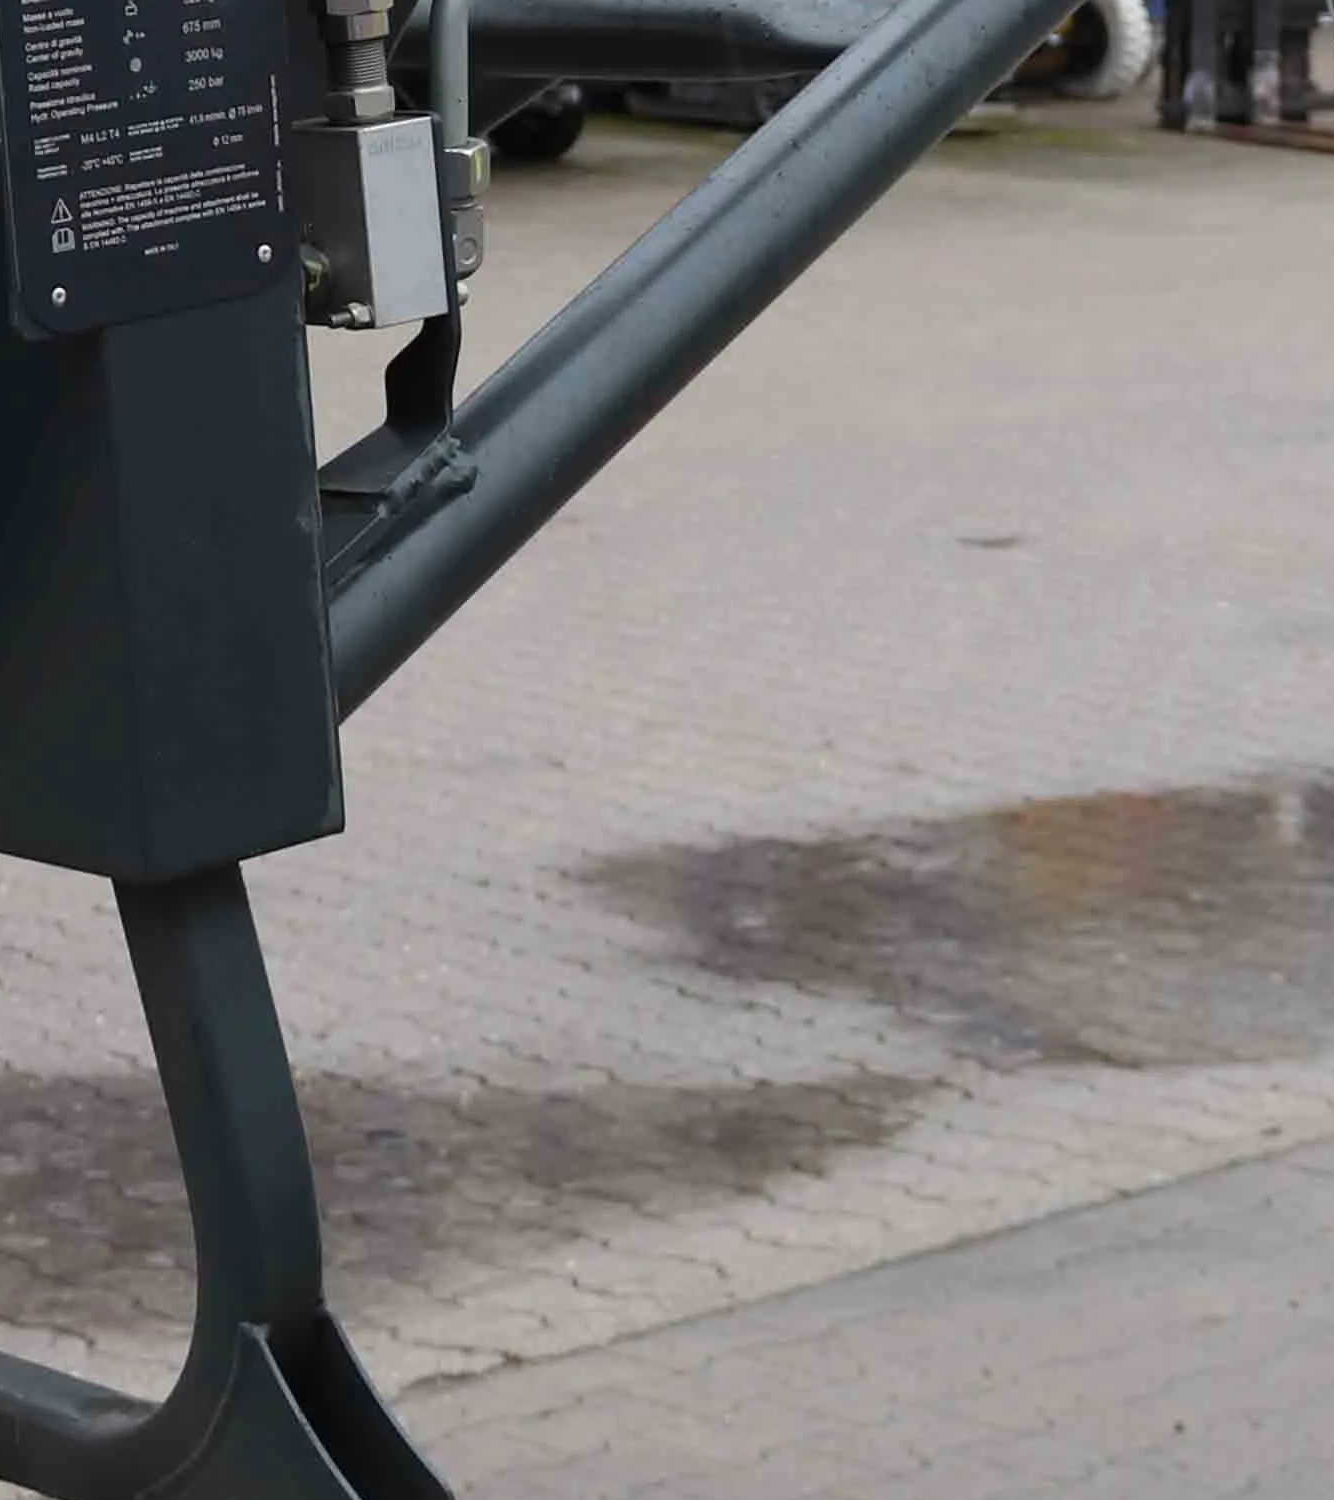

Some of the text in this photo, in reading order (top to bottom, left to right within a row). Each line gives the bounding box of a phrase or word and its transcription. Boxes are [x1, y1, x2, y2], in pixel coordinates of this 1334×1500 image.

[182, 18, 221, 35] 675 mm
[184, 45, 224, 64] 3000 kg
[188, 74, 225, 91] 250 bar
